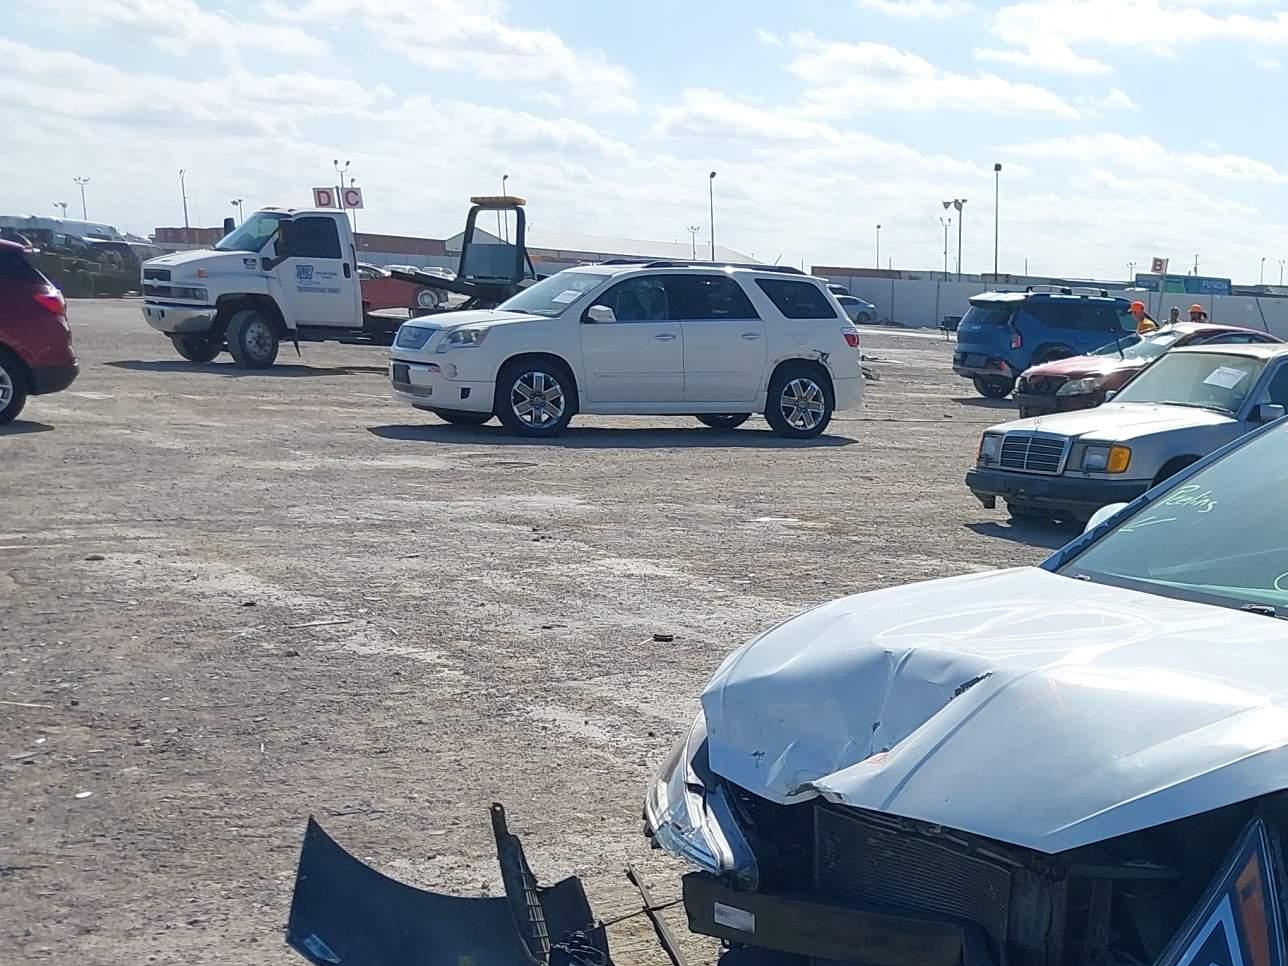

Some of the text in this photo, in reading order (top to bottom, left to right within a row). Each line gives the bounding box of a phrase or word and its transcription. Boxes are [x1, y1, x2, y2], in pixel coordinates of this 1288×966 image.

[316, 191, 331, 206] D
[345, 190, 359, 206] C
[1154, 259, 1164, 272] B
